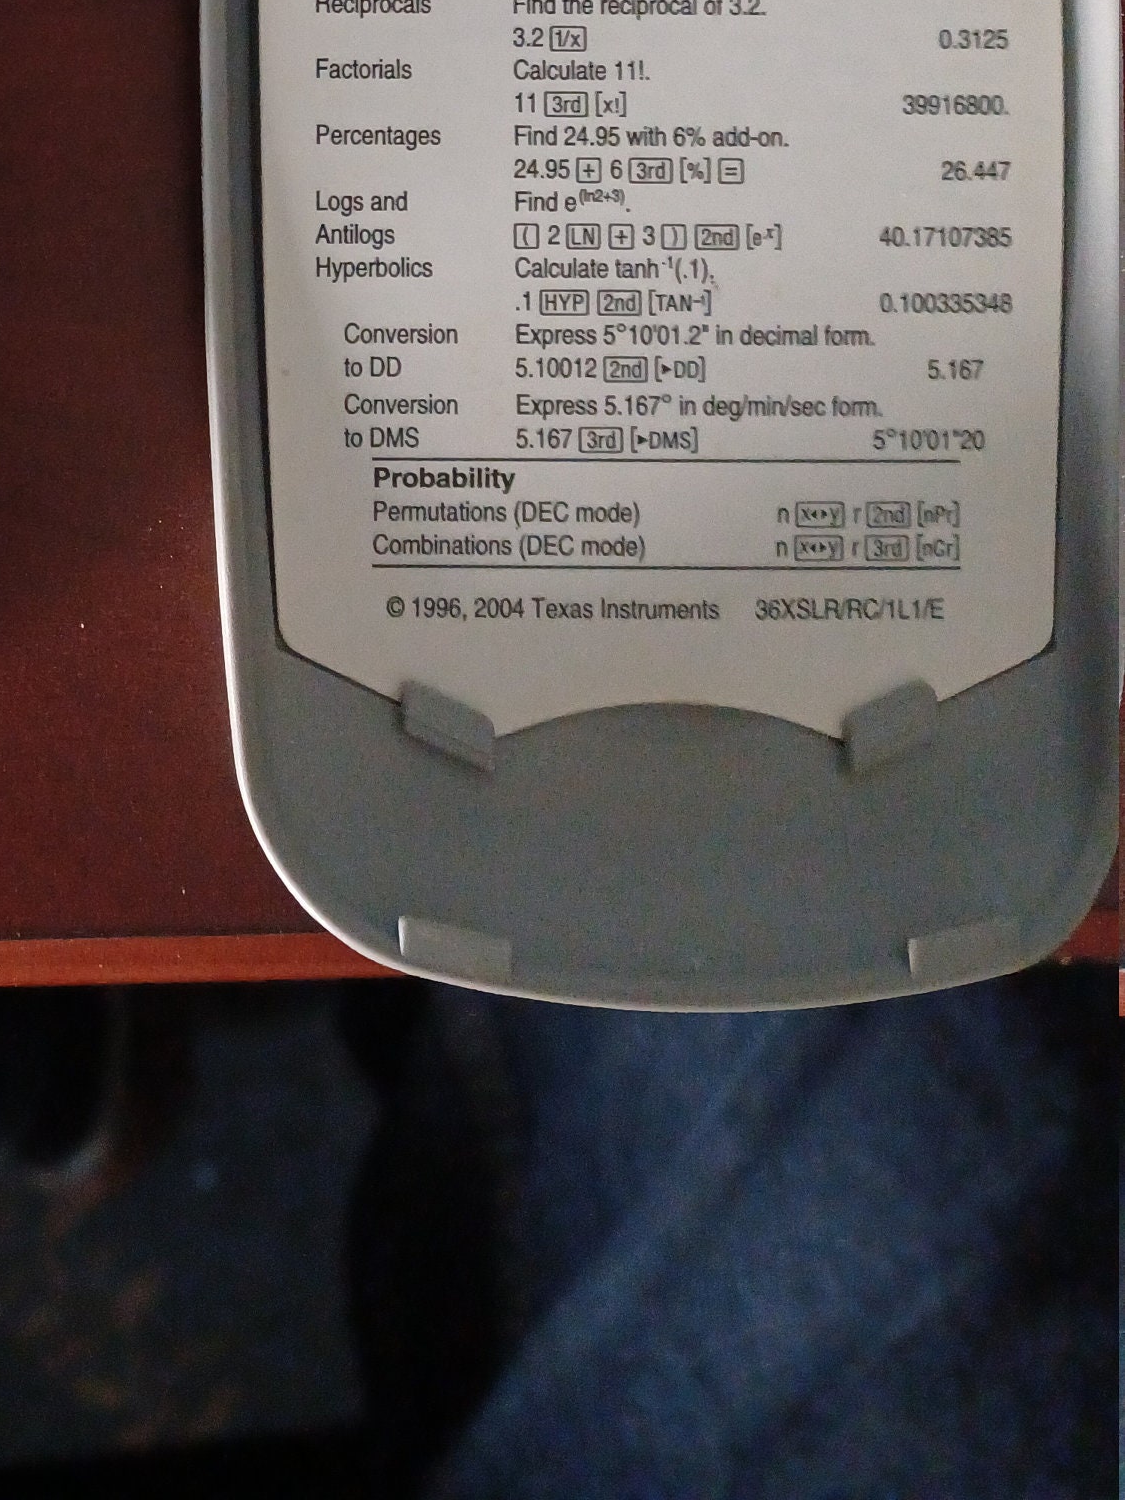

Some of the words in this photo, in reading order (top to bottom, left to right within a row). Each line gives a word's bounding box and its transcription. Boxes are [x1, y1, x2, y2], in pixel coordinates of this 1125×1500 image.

[316, 58, 412, 79] Factorials
[514, 59, 606, 80] Calculate
[316, 124, 441, 151] Percentages
[514, 125, 557, 146] Find
[564, 126, 620, 146] 24.95
[626, 126, 667, 146] with
[673, 126, 706, 147] 6%
[712, 126, 789, 147] add-on.
[316, 190, 364, 217] Logs
[371, 191, 407, 211] and
[315, 224, 395, 250] Antilogs
[316, 256, 432, 283] Hyperbolics
[515, 257, 609, 278] Calculate
[344, 322, 458, 344] Conversion
[516, 323, 597, 350] Express
[344, 358, 363, 377] to
[370, 356, 401, 377] DD
[344, 393, 458, 415] Conversion
[516, 394, 597, 420] Express
[344, 428, 363, 448] to
[370, 427, 419, 448] DMS
[374, 467, 515, 494] Probability
[373, 500, 506, 522] Permutations
[514, 501, 569, 529] (DEC
[576, 502, 640, 528] mode)
[373, 534, 512, 555] Combinations
[519, 535, 574, 561] (DEC
[582, 535, 645, 562] mode)
[413, 597, 467, 621] 1996,
[474, 597, 524, 618] 2004
[531, 597, 593, 619] Texas
[601, 598, 720, 620] Instruments
